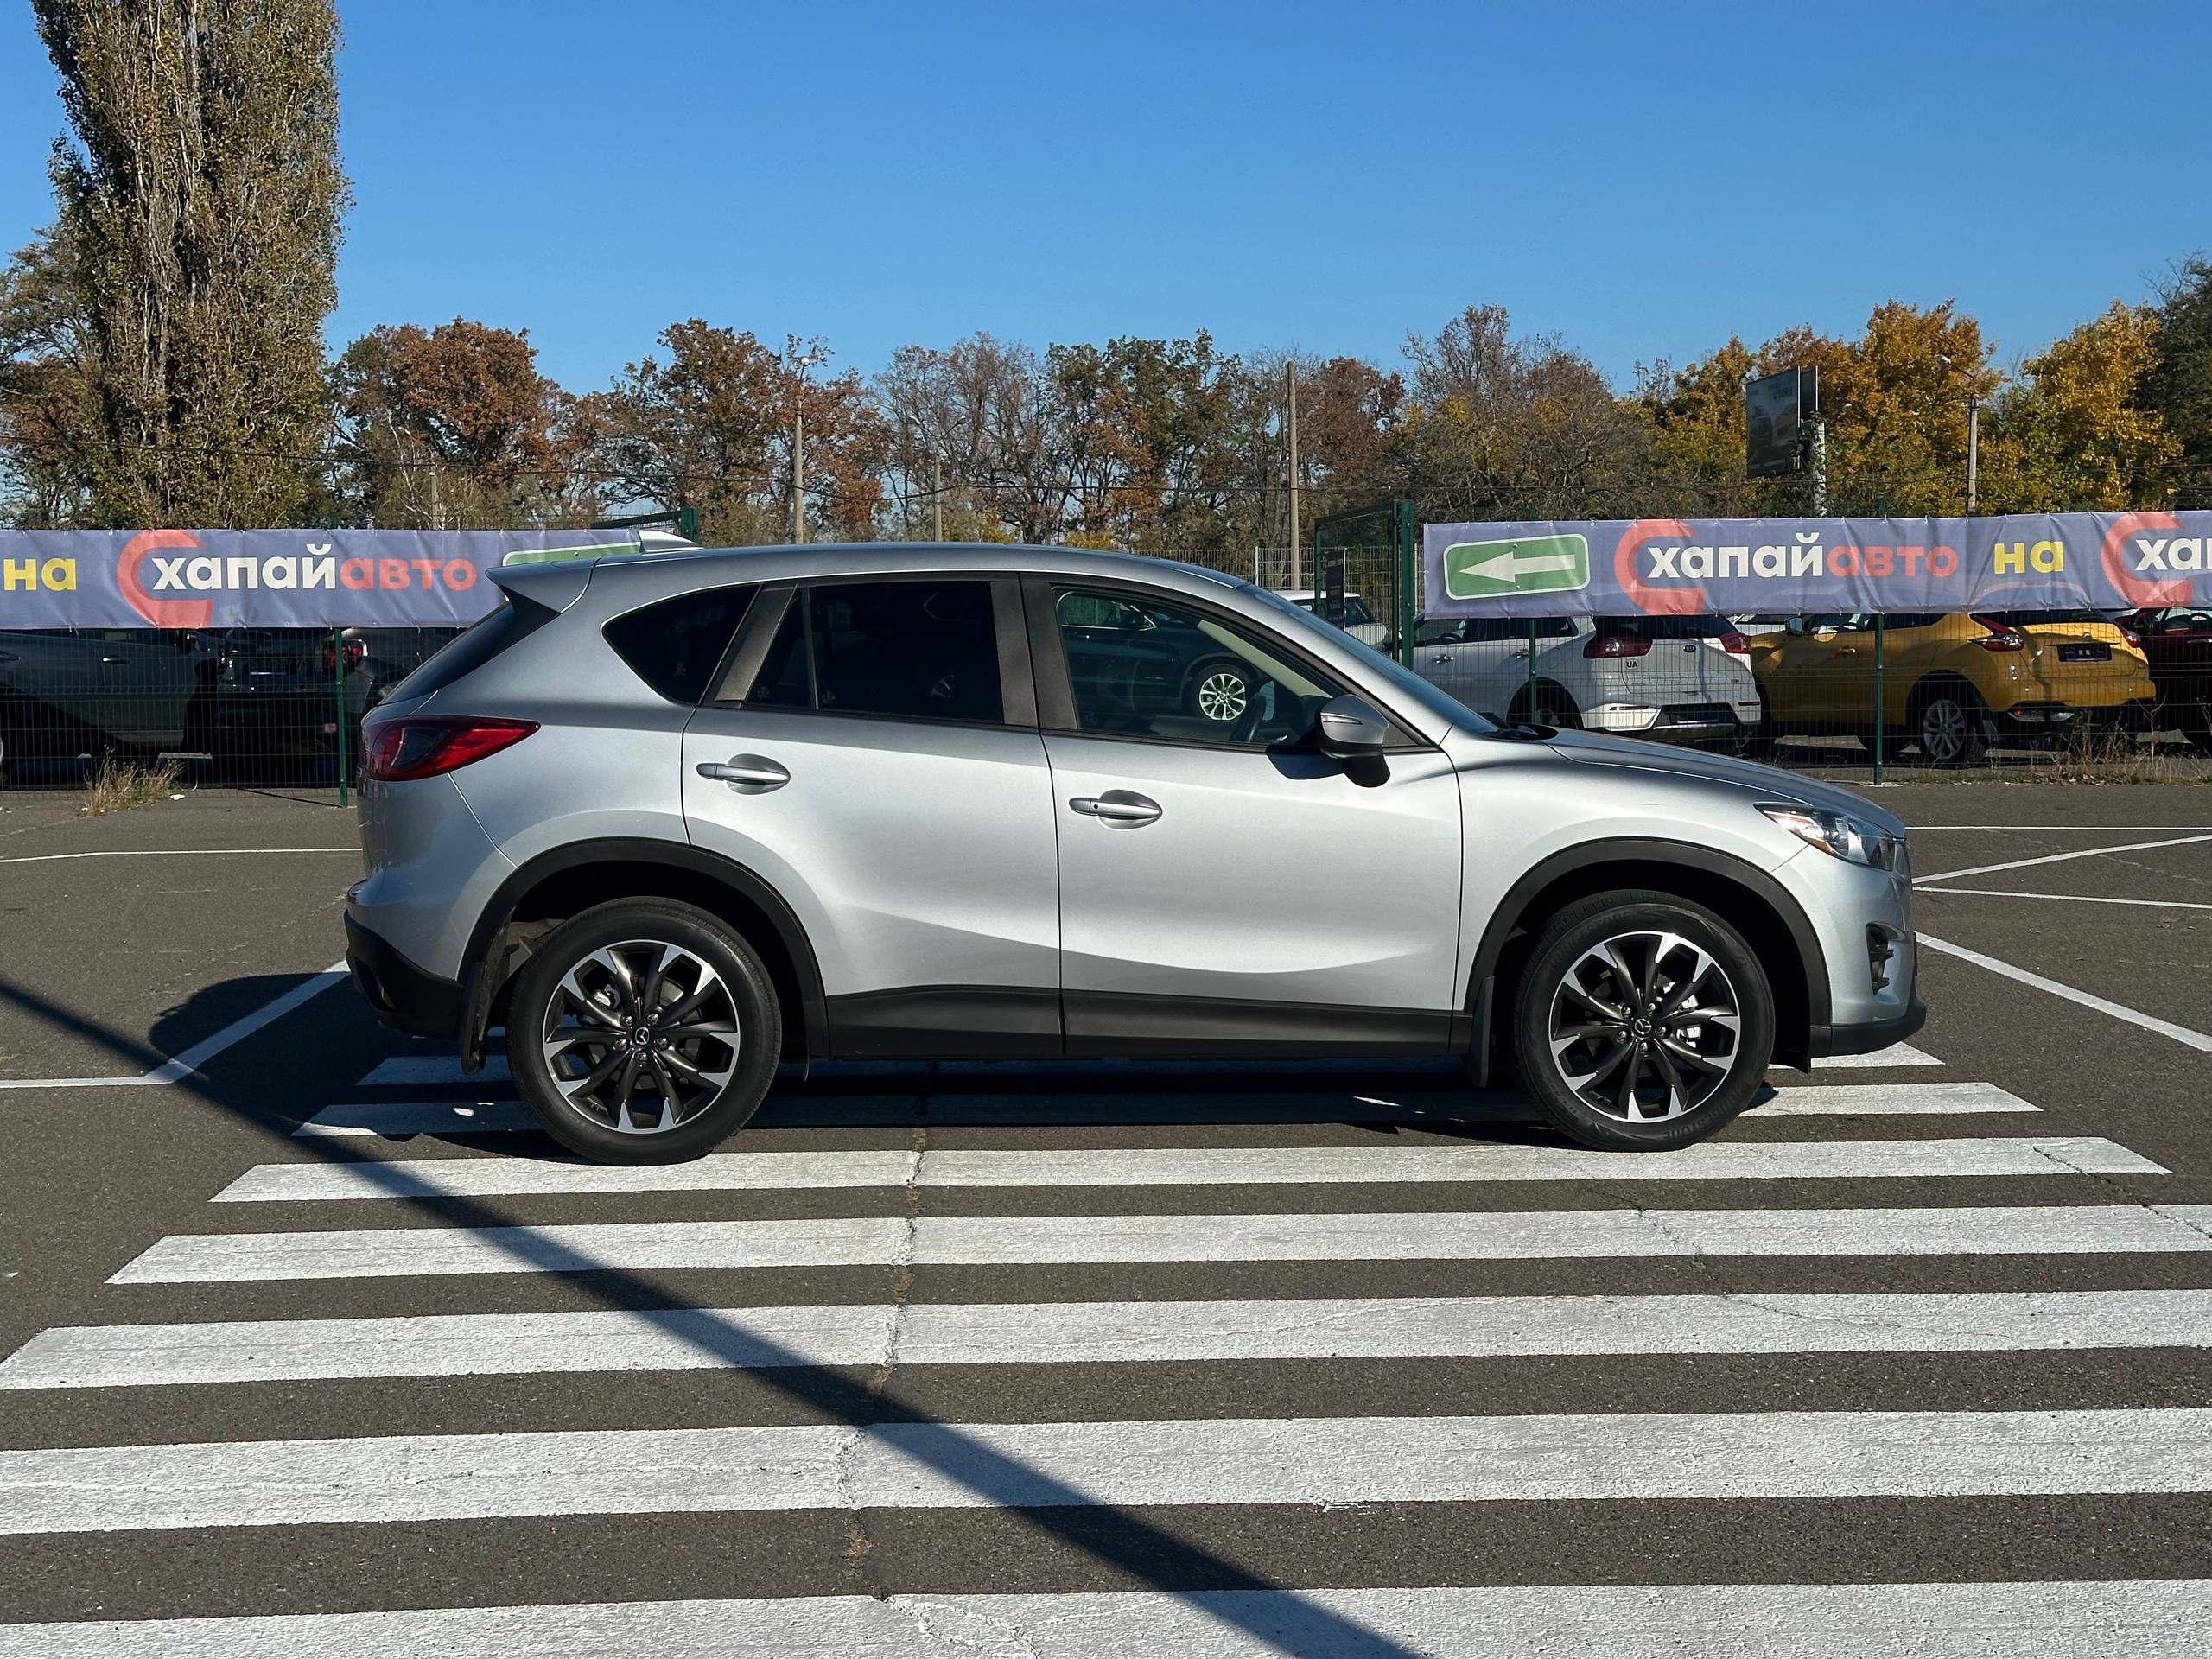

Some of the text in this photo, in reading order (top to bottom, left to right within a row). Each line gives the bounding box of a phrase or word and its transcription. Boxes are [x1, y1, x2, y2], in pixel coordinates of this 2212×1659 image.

[1993, 540, 2065, 575] на
[2135, 537, 2212, 571] ха
[3, 558, 77, 591] на
[1626, 660, 1638, 669] UA
